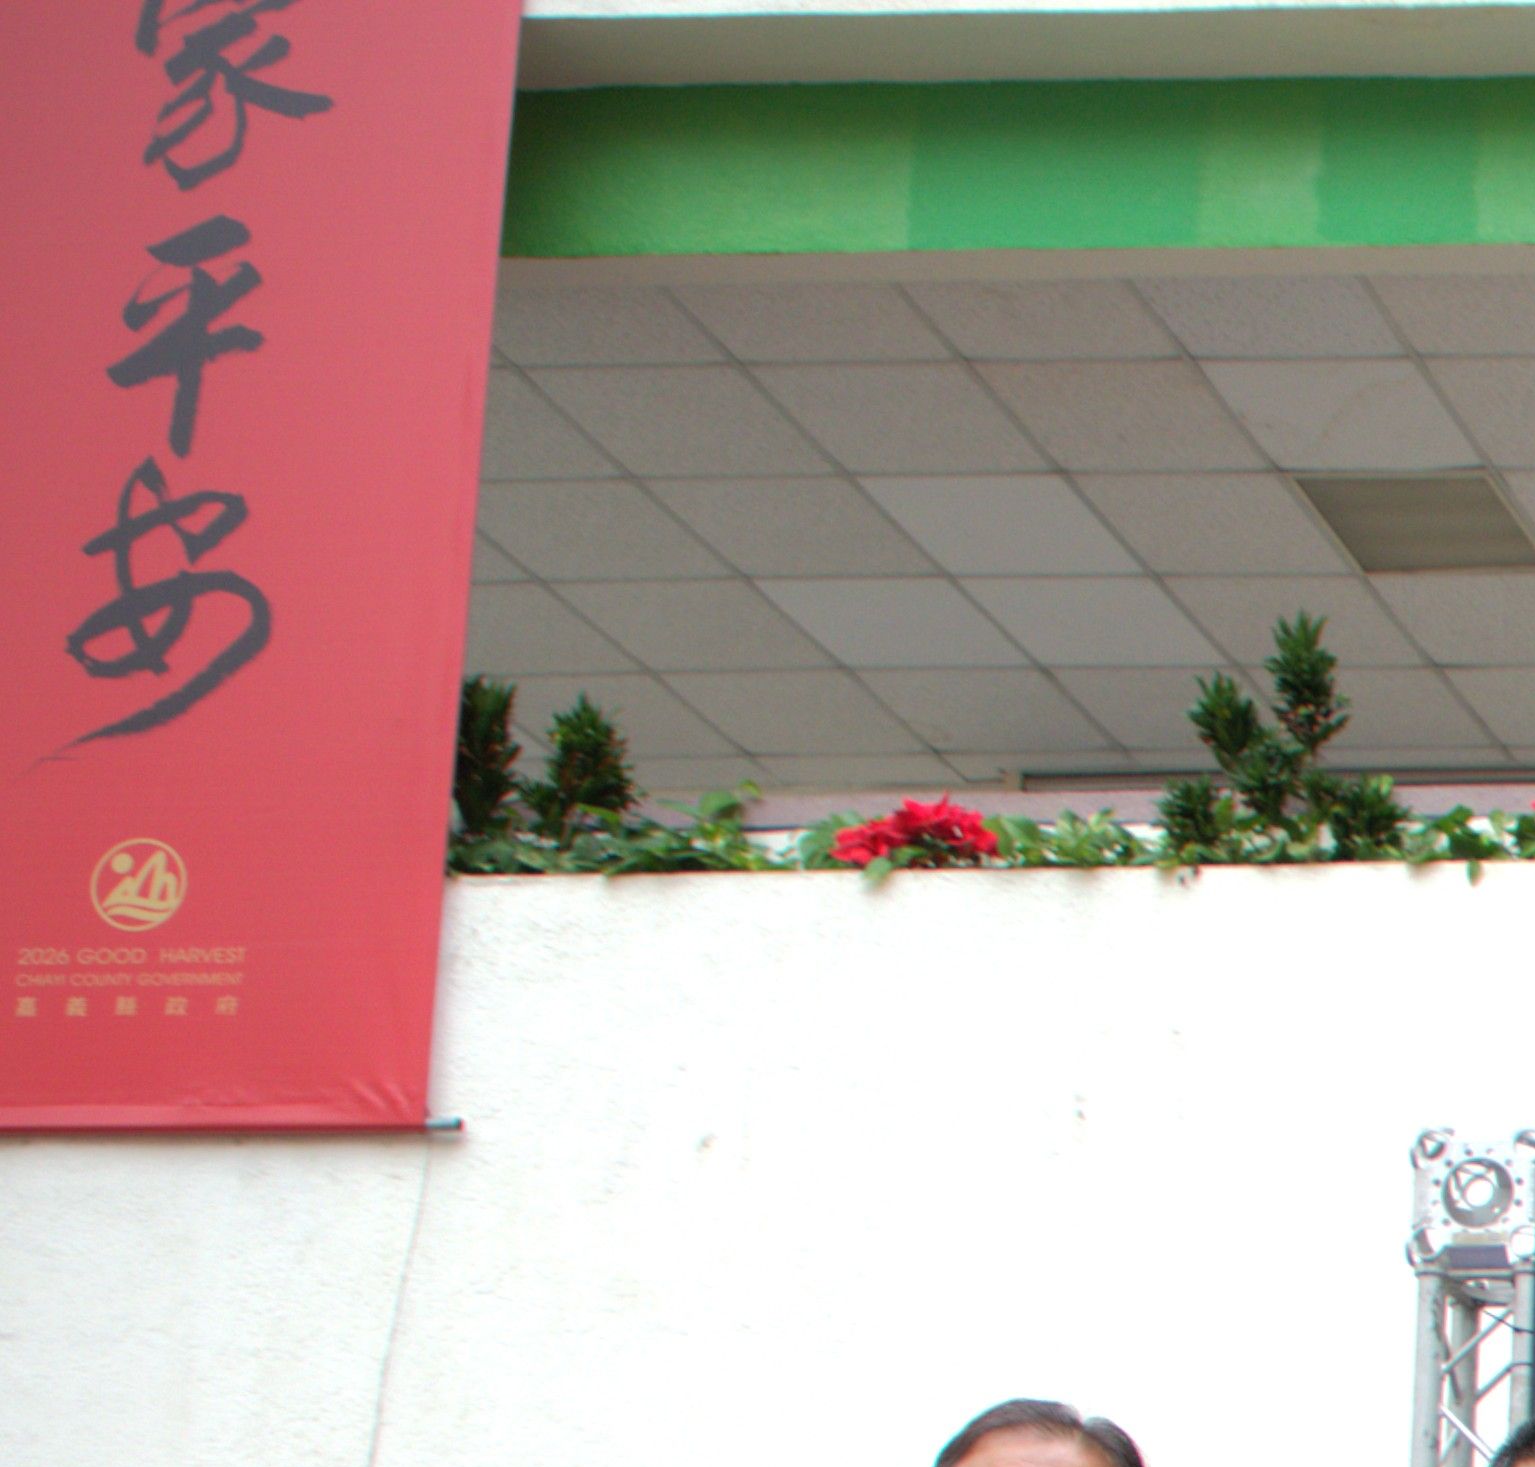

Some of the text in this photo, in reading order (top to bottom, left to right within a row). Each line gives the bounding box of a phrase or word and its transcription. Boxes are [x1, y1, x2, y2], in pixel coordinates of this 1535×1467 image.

[17, 947, 247, 966] 2026 GOOD HARVEST
[70, 973, 132, 987] COUNTY
[137, 972, 244, 987] GOVERNMENT
